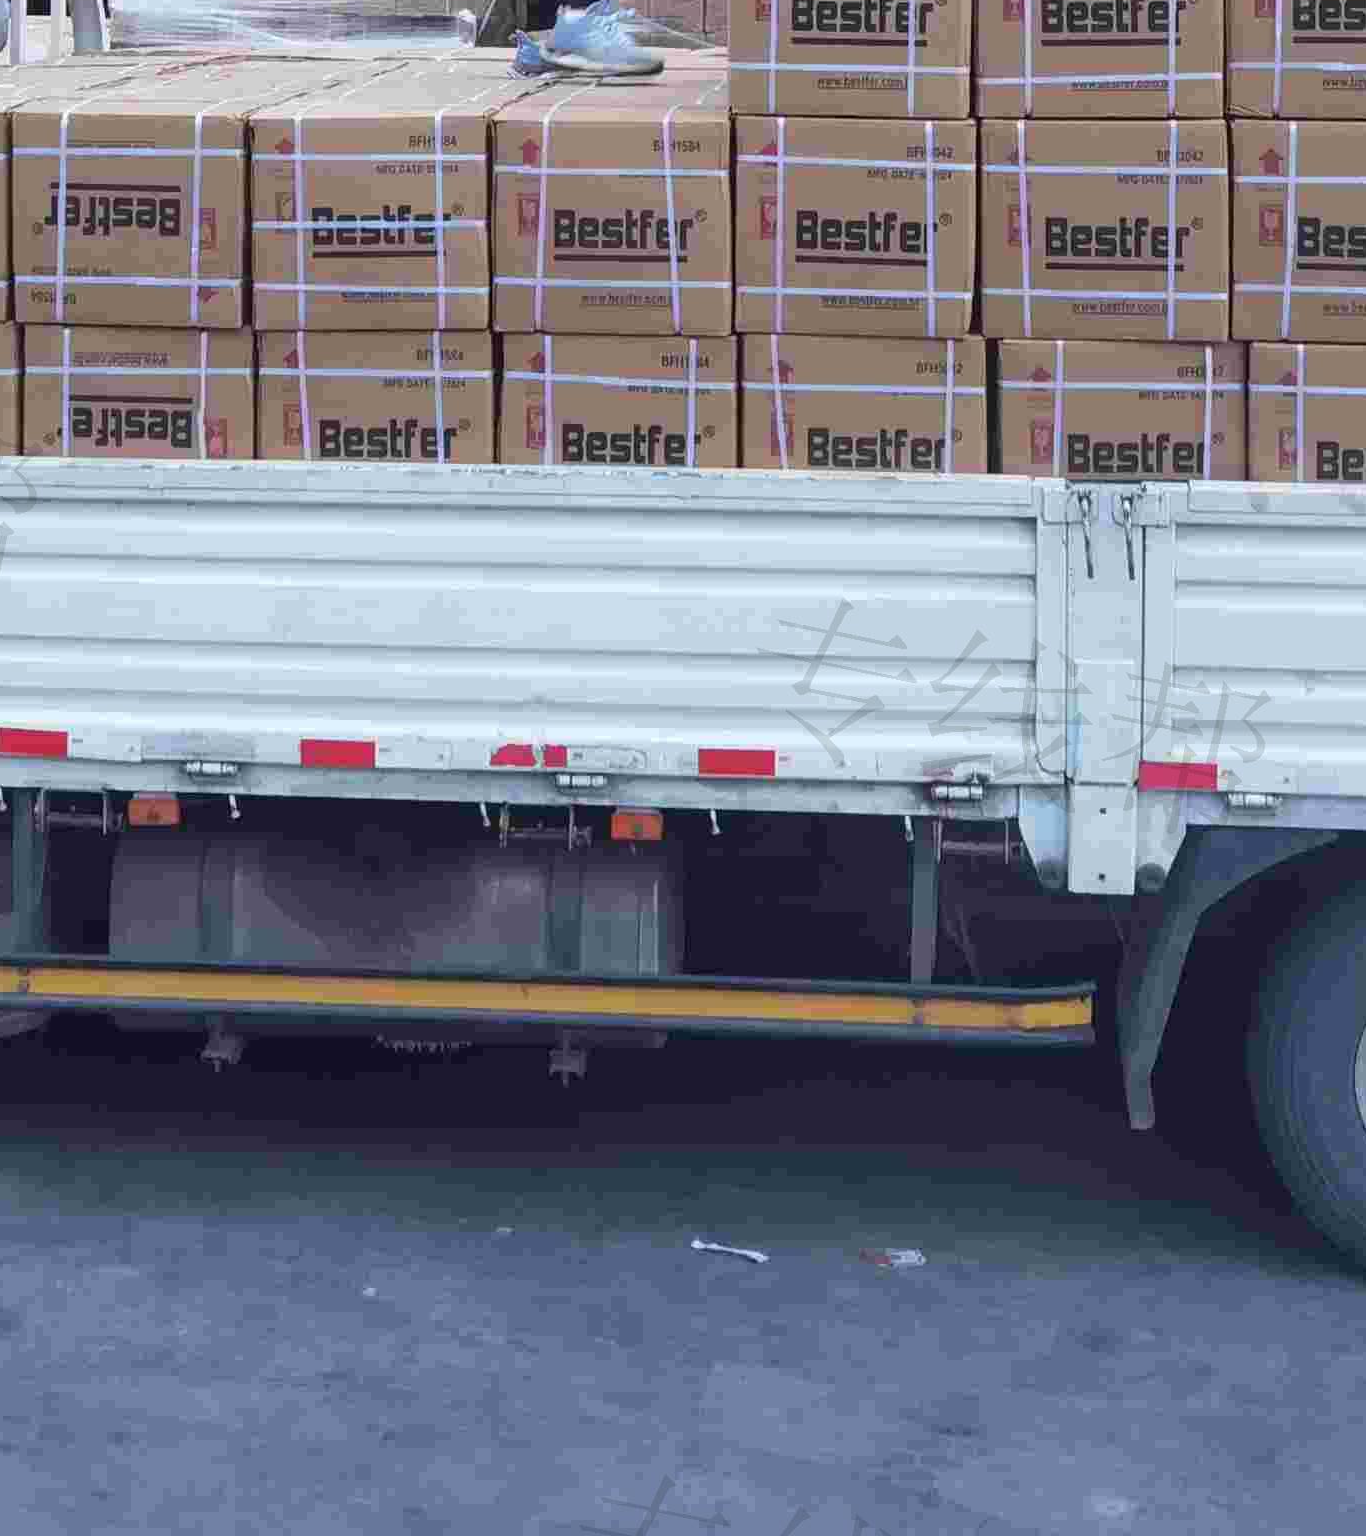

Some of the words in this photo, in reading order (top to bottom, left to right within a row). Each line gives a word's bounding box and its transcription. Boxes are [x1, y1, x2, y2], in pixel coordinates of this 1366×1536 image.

[44, 195, 181, 236] Bestfer
[312, 205, 452, 245] Bestfer
[553, 209, 695, 249] Bestfer
[1045, 217, 1190, 258] Bestfer
[319, 418, 457, 460] Bestfer
[562, 422, 703, 464] Bestfer
[807, 427, 947, 469] Bestfer
[1066, 433, 1207, 475] Bestfer
